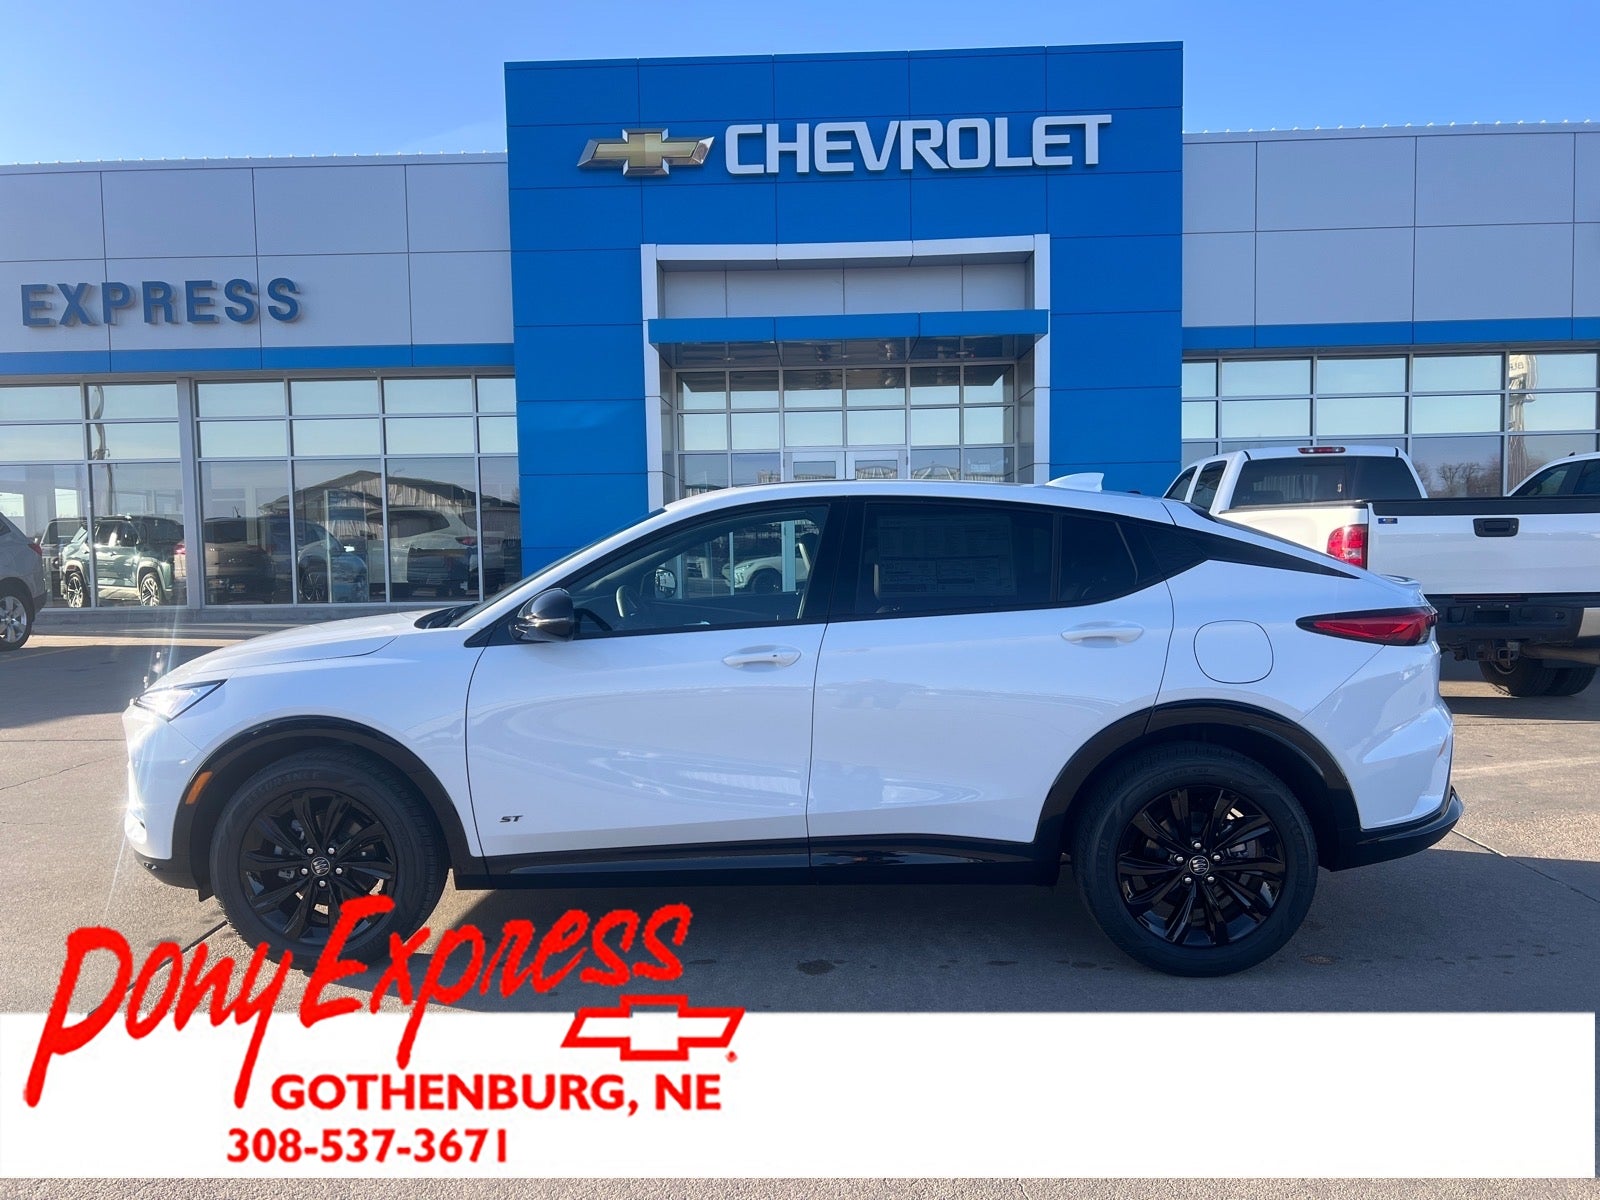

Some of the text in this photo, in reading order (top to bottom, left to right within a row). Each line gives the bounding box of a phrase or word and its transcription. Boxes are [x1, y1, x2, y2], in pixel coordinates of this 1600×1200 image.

[725, 114, 1112, 175] CHEVROLET
[21, 277, 303, 327] EXPRESS
[500, 815, 523, 823] ST
